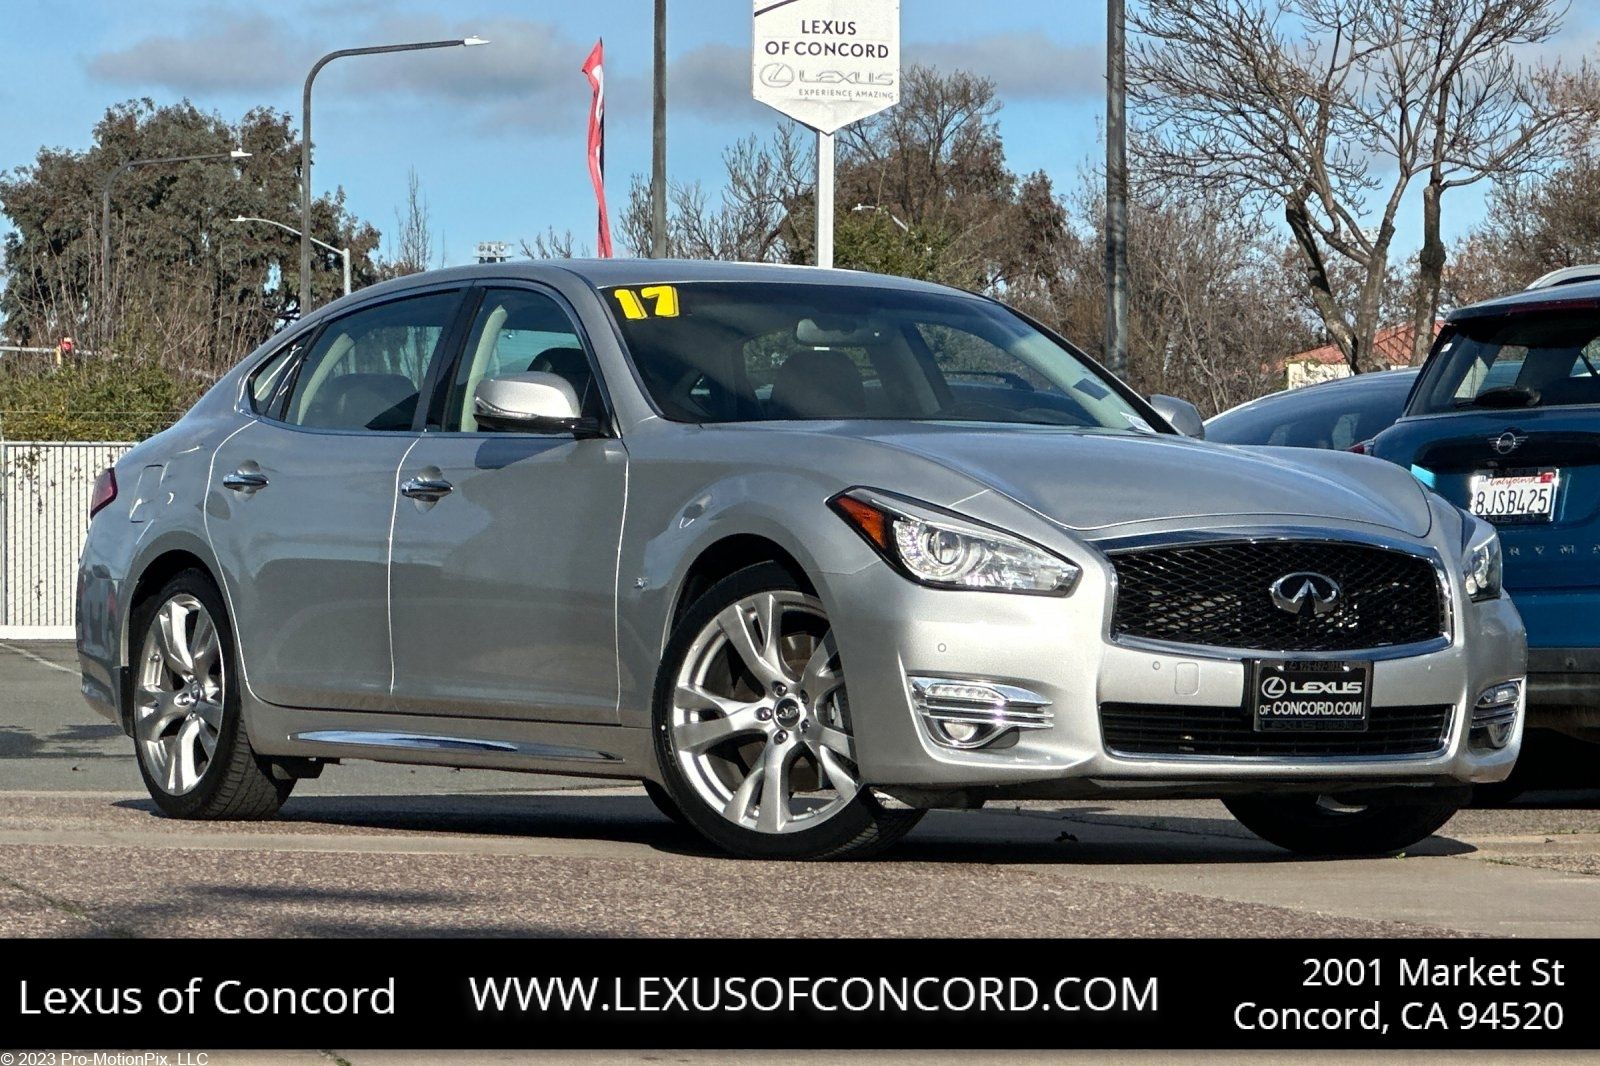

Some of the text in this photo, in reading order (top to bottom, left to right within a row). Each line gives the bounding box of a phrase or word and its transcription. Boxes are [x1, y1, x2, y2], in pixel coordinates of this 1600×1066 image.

[801, 20, 857, 35] LEXUS
[765, 41, 889, 58] OF CONCORD
[799, 70, 894, 86] LEXUS
[799, 89, 893, 99] EXPERIENCE AMAZING
[614, 285, 679, 319] 17
[1475, 488, 1548, 514] 8JSB425
[1290, 681, 1362, 694] LEXUS
[1260, 701, 1362, 715] OF CONCORD.COM
